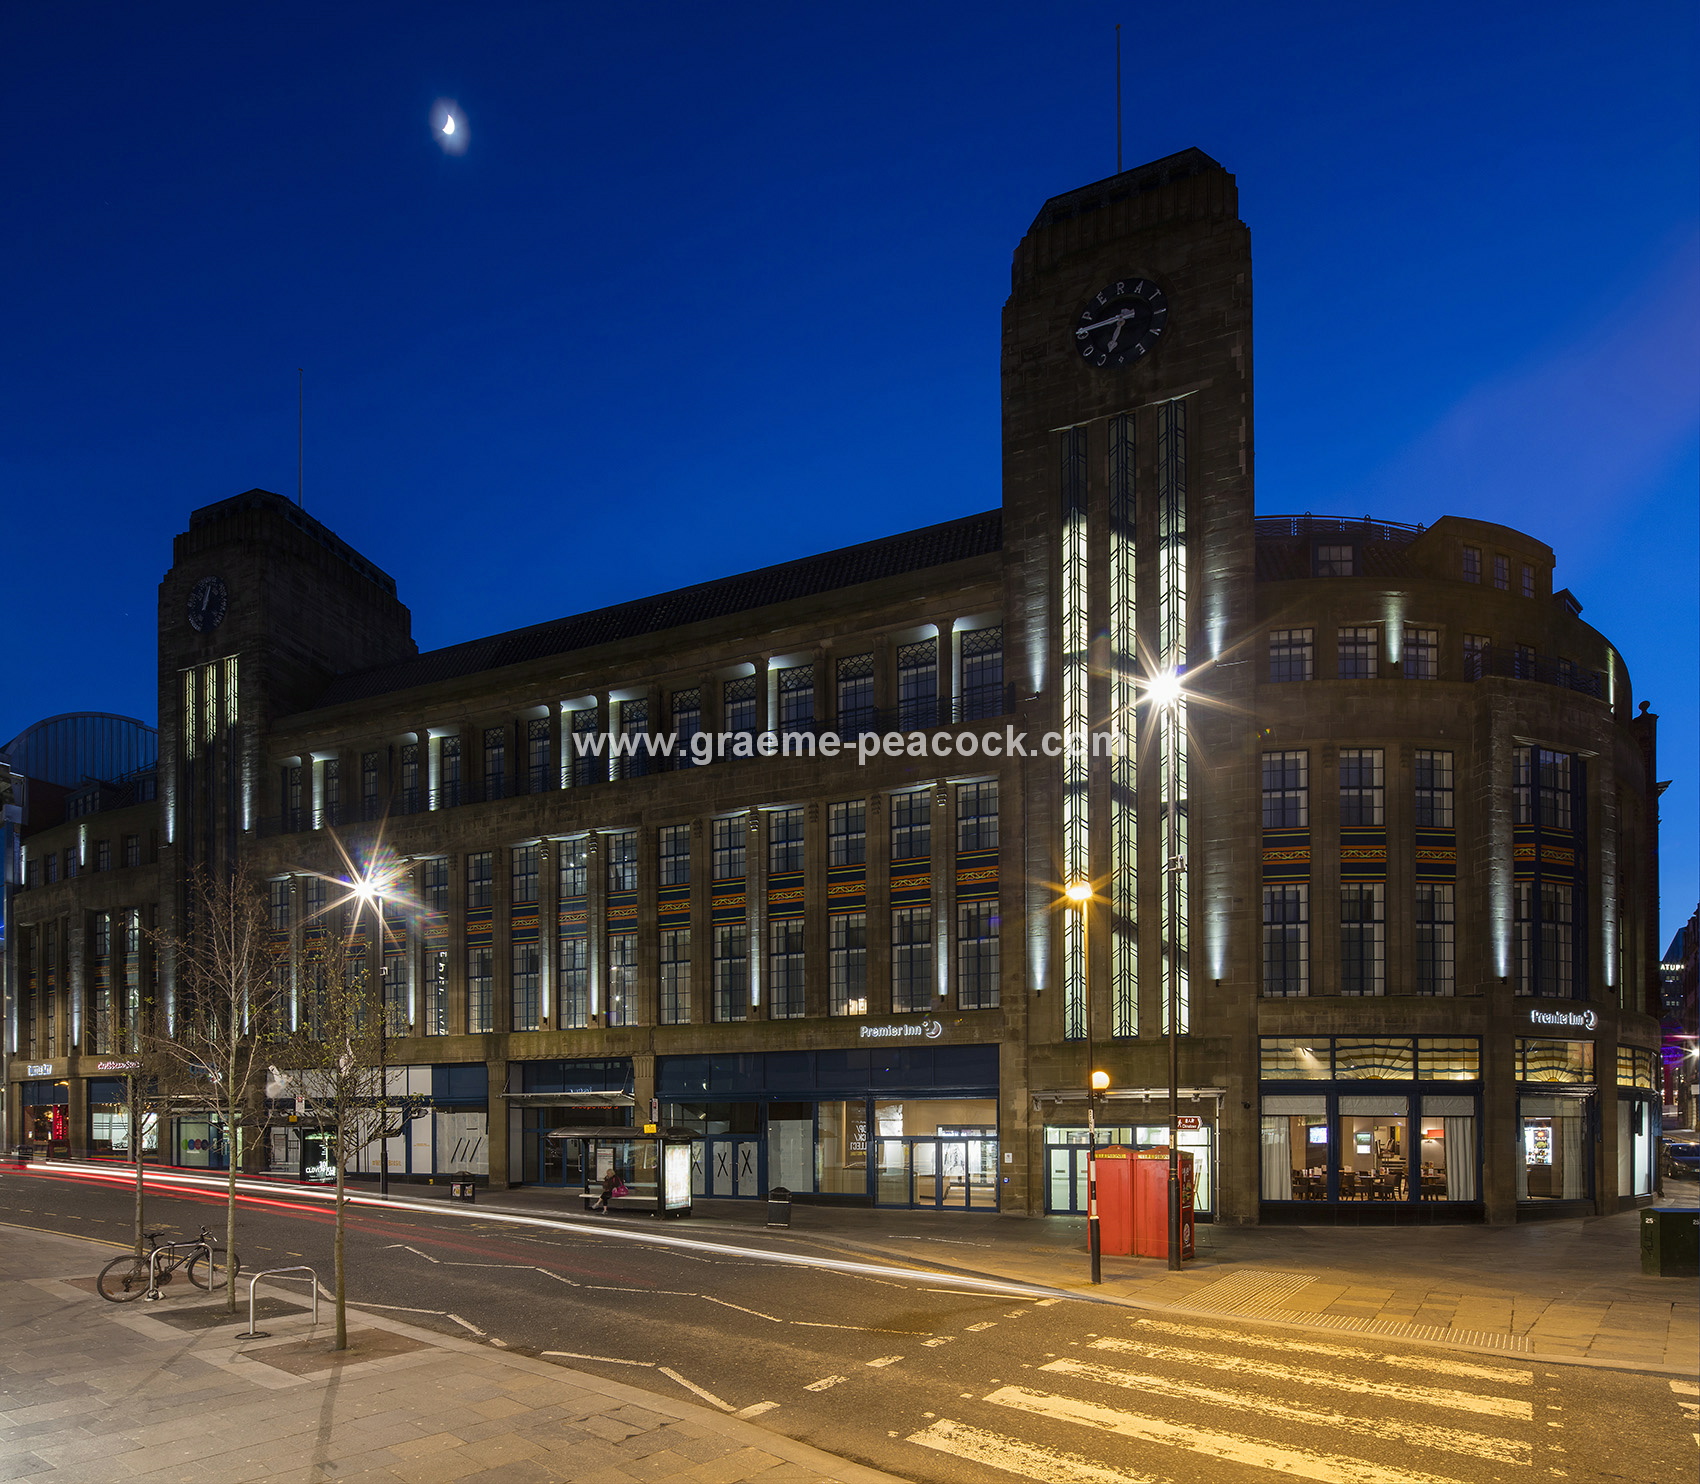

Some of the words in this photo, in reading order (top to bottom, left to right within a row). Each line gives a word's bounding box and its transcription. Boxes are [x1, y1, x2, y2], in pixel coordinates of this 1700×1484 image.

[1530, 1009, 1568, 1025] Premier
[1569, 1012, 1584, 1026] Inn
[860, 1025, 903, 1038] Premier
[904, 1024, 922, 1036] Inn
